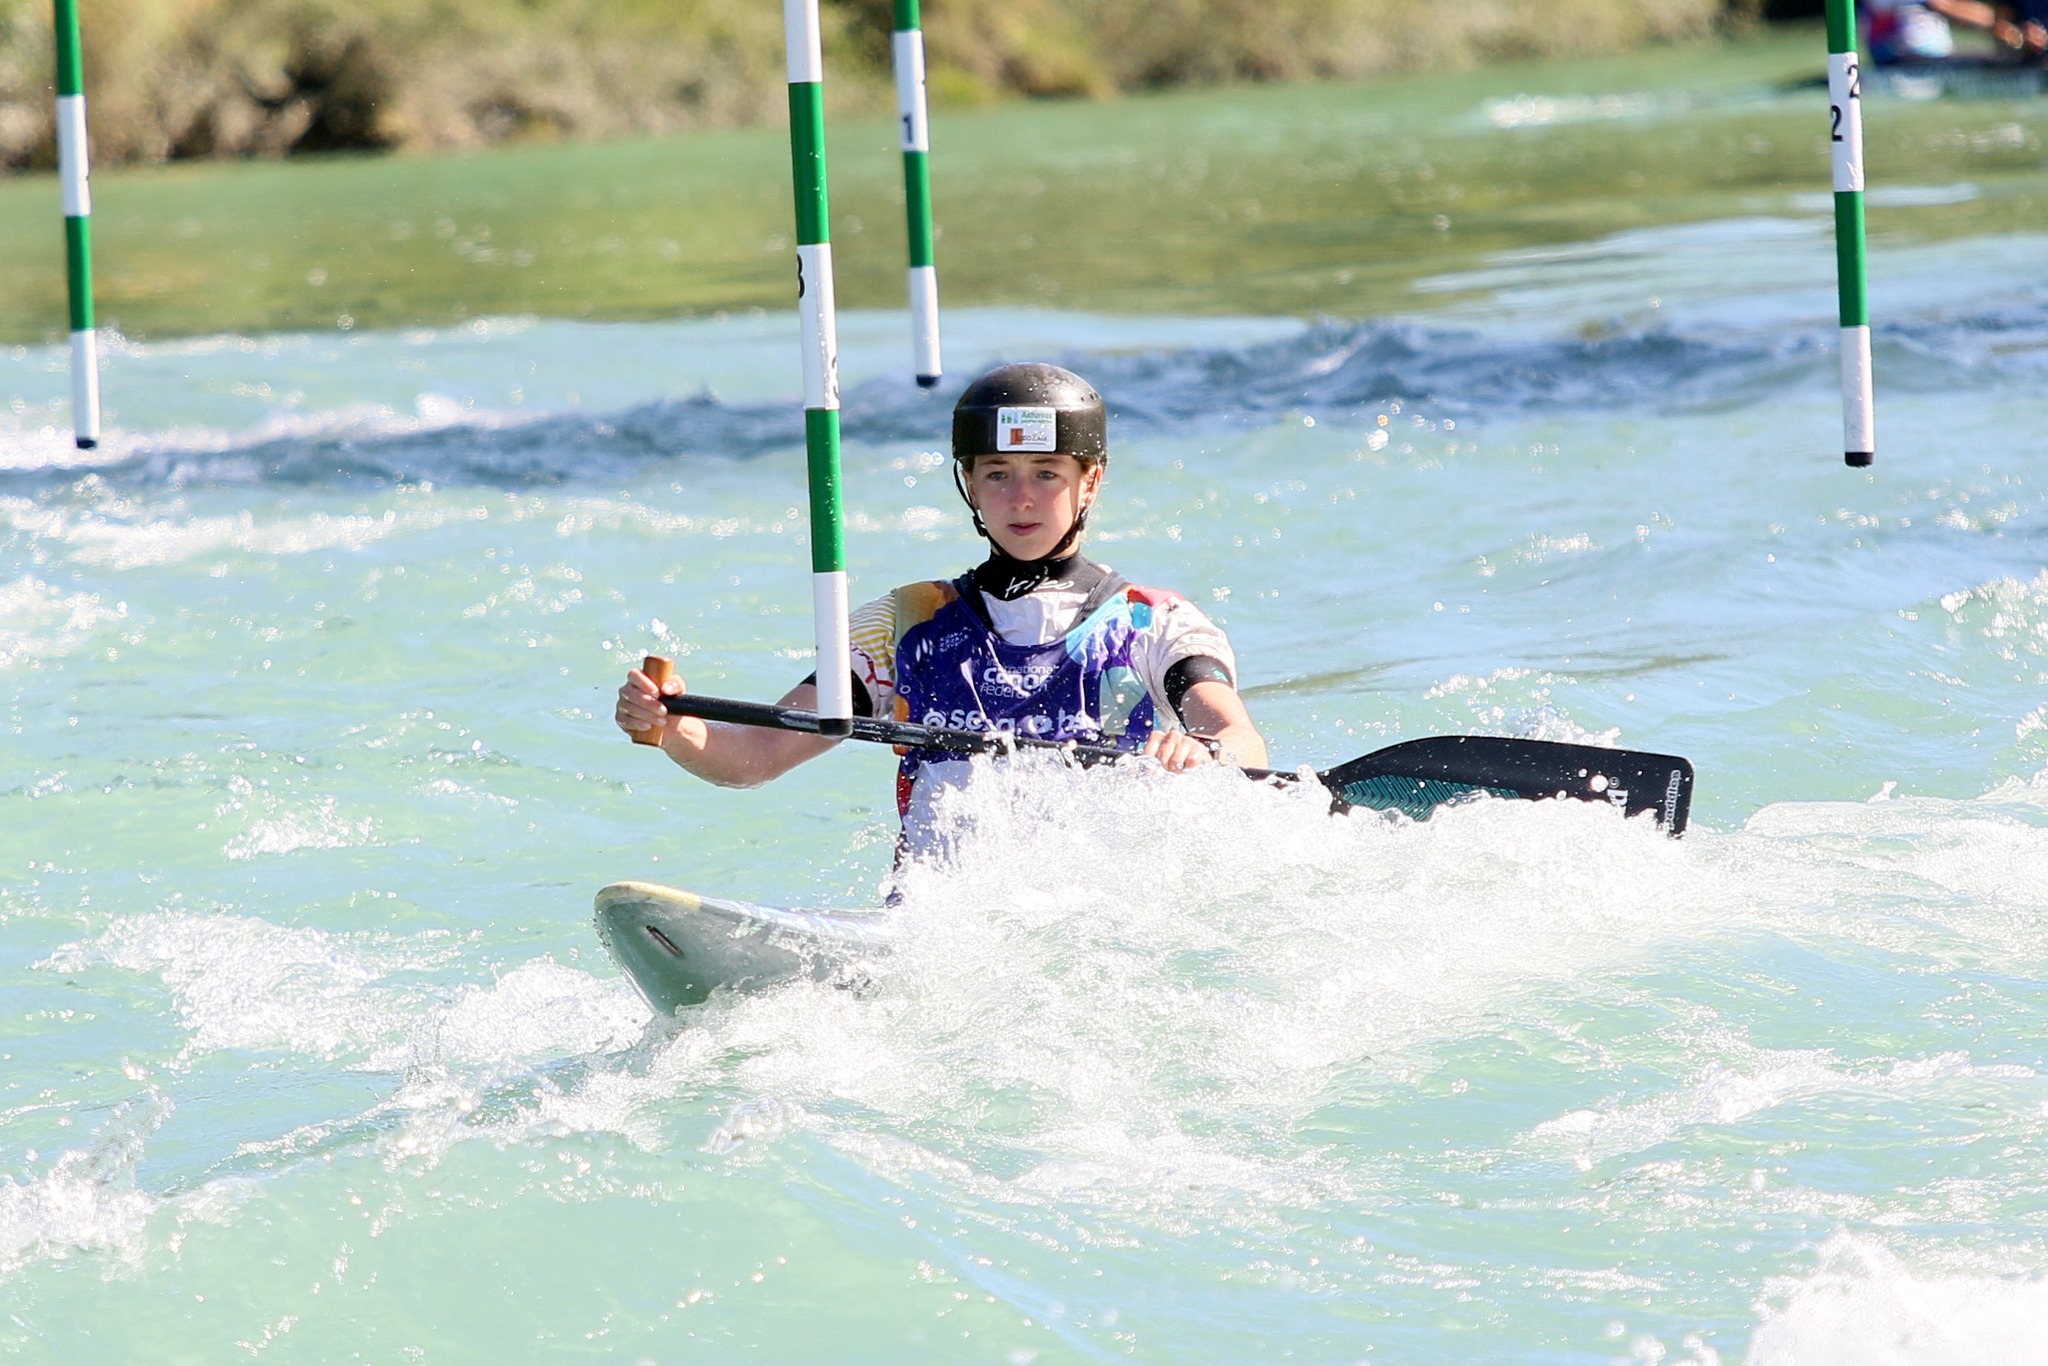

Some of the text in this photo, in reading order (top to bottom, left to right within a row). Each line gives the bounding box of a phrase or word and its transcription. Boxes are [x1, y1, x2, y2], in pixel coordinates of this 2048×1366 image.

[1848, 64, 1860, 98] 2
[903, 113, 913, 144] 1
[1831, 105, 1843, 142] 2
